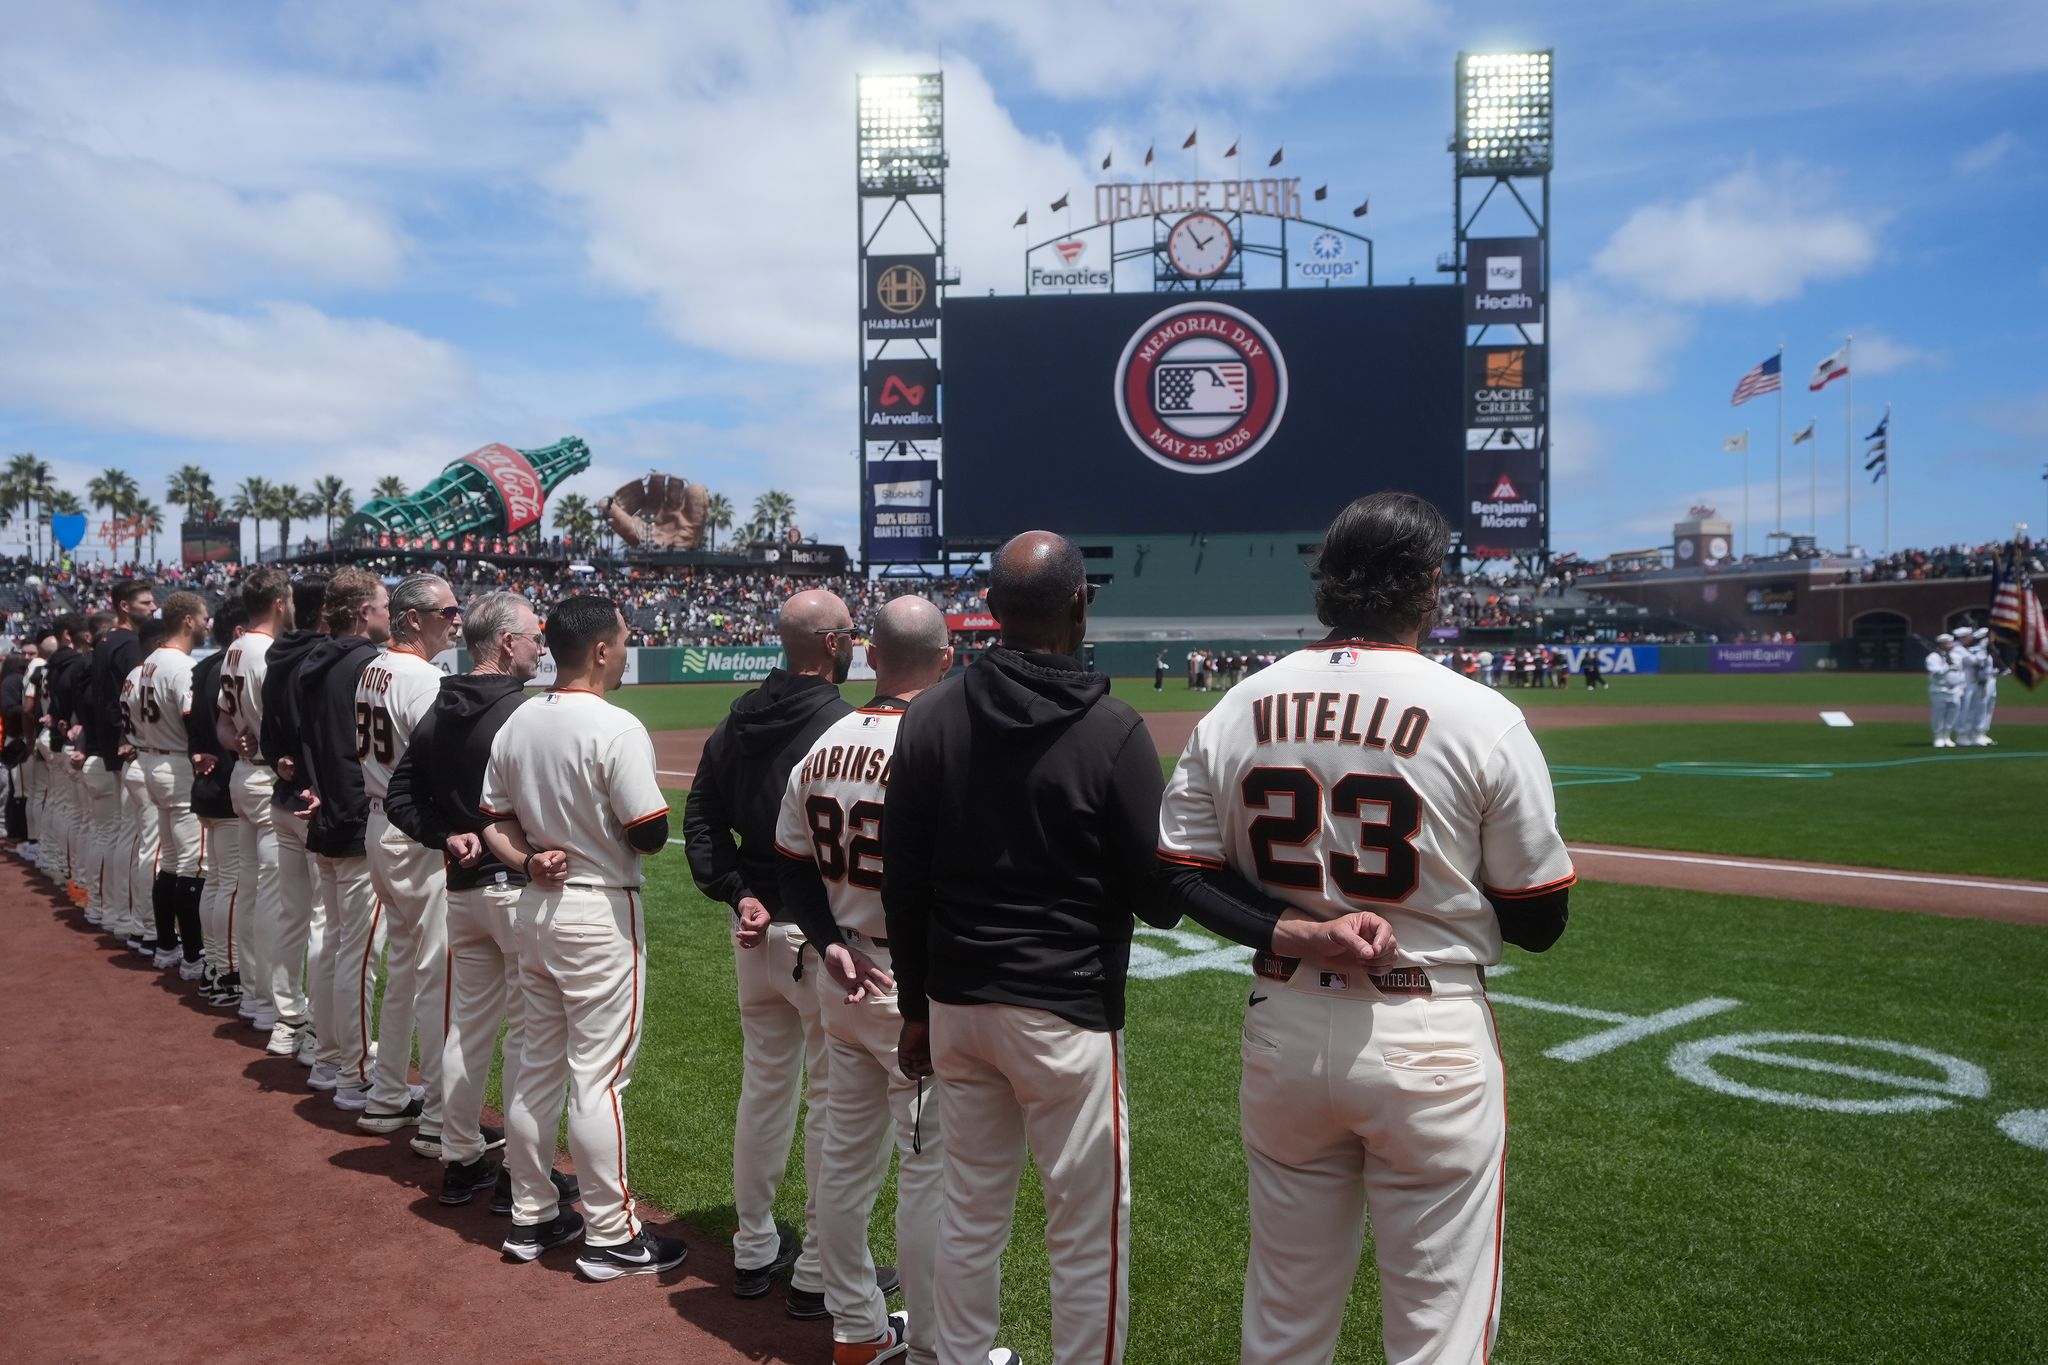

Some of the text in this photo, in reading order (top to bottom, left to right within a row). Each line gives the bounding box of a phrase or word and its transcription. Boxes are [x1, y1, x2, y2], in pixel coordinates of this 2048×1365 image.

[1095, 177, 1301, 225] ORACLE PARK
[1032, 268, 1109, 286] Fanatics
[1303, 262, 1353, 280] coupa
[1475, 293, 1533, 310] Health
[868, 318, 935, 329] HABBAS LAW
[1139, 317, 1264, 362] MEMORIAL DAY
[1474, 389, 1534, 402] CACHE
[1476, 402, 1531, 415] CREEK
[871, 411, 934, 425] Airwallex
[1151, 428, 1251, 459] MAY 25, 2026
[1471, 501, 1537, 517] Benjamin
[876, 512, 931, 525] 100% VERIFIED
[1481, 515, 1528, 528] Moore
[874, 525, 933, 538] GIANTS TICKETS
[963, 617, 993, 627] Adobe
[706, 652, 783, 671] National
[1565, 647, 1636, 673] VSA
[1718, 649, 1793, 662] HealthEquity
[733, 671, 768, 681] Car Ren
[1253, 691, 1430, 758] VITELLO
[1241, 765, 1422, 904] 23
[805, 794, 885, 892] 82
[1265, 958, 1283, 974] TONY
[1380, 973, 1425, 988] VITELLO
